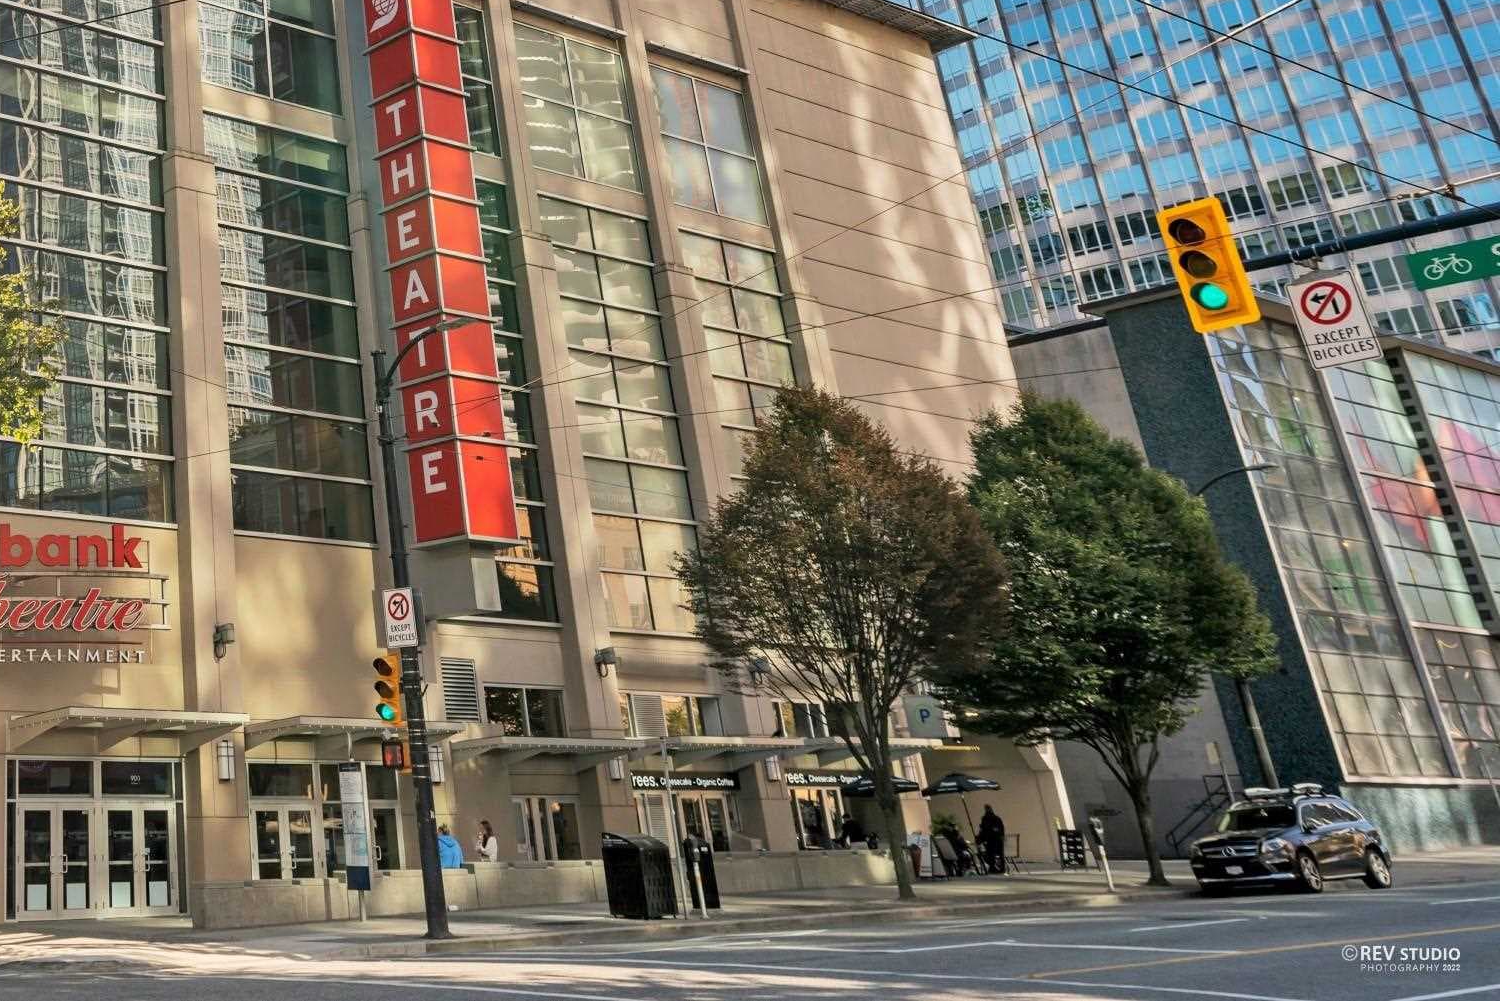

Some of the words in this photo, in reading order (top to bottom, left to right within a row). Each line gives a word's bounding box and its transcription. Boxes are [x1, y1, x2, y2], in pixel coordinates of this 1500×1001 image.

[386, 99, 447, 494] THEATRE
[1314, 326, 1362, 345] EXCEPT
[1313, 339, 1375, 361] BICYCLES
[390, 623, 411, 632] EXCEPT
[388, 632, 416, 642] BICYCLES
[631, 774, 659, 787] rees.
[660, 777, 693, 786] Ceesecake
